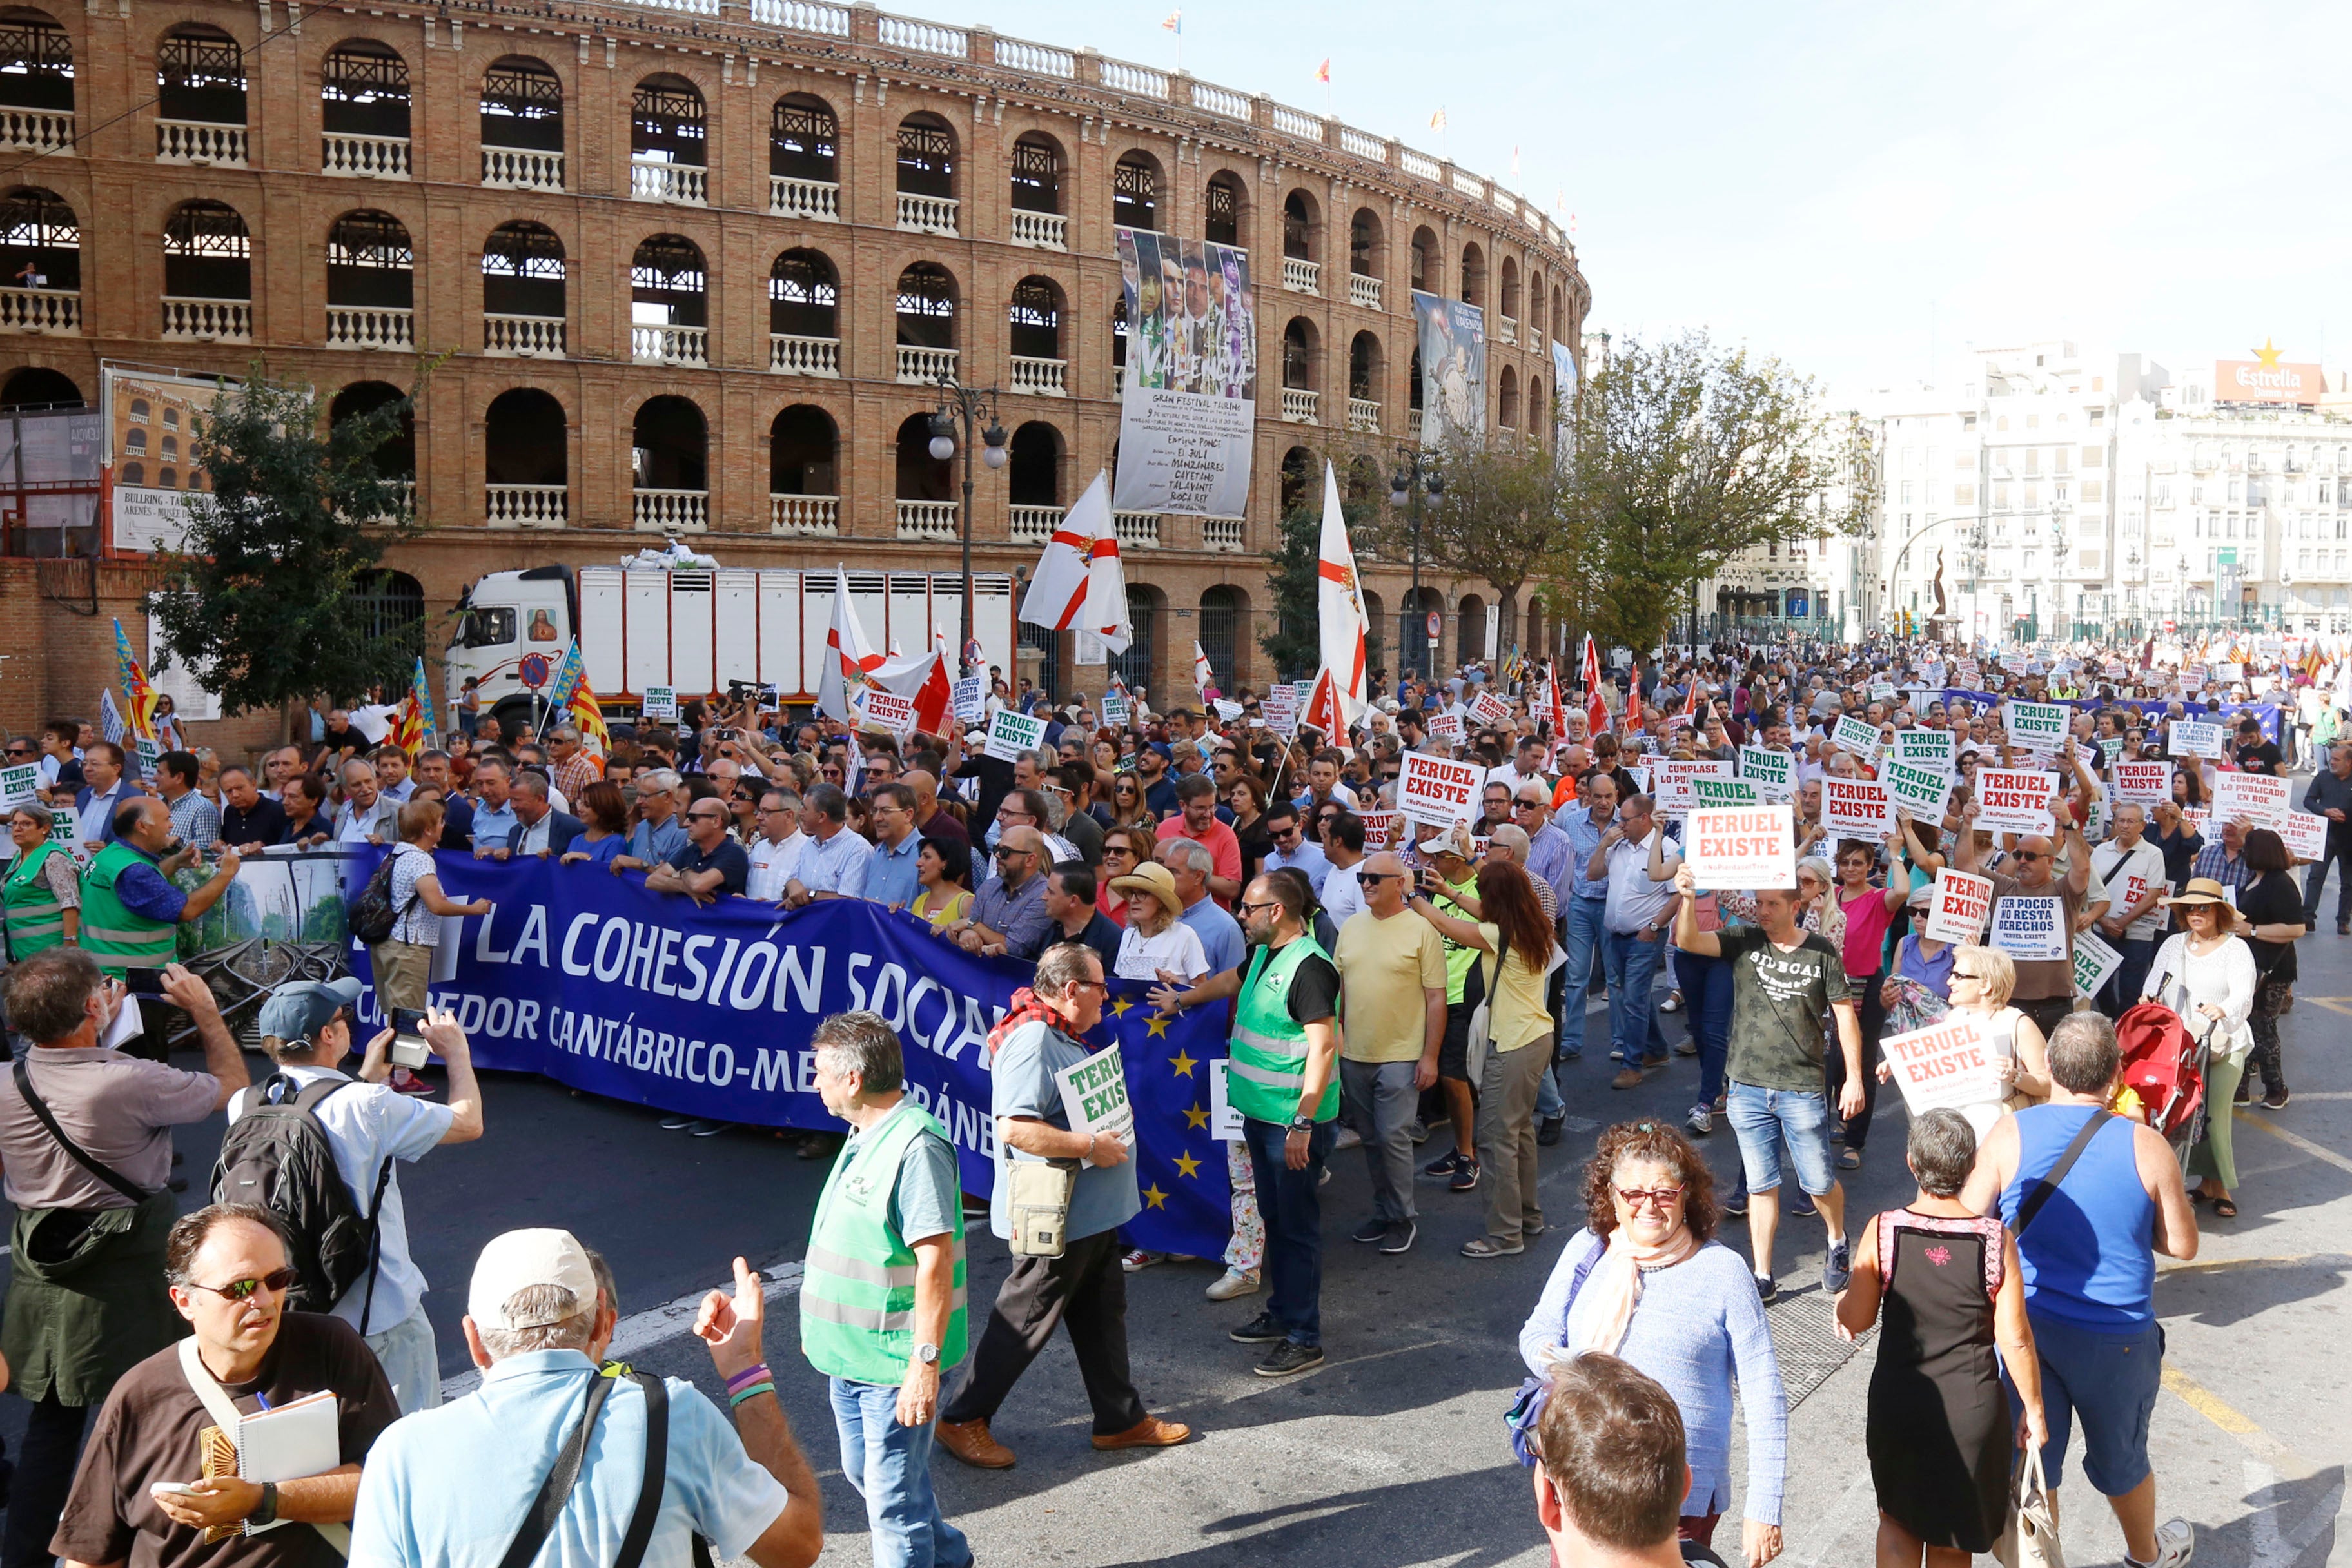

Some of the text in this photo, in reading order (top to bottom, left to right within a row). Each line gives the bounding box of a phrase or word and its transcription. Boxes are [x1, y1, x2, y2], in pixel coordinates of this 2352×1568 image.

[1140, 338, 1256, 385] VALENCIA
[2235, 366, 2301, 387] Estrella
[1153, 394, 1174, 404] GRAN
[1176, 397, 1210, 409] FESTIVAL
[1213, 401, 1241, 411] TAURINO
[1168, 435, 1222, 449] Enrique PONCE
[1171, 458, 1224, 472] MANZANARES
[1174, 469, 1215, 482] CAYETANO
[1168, 480, 1213, 492] TALAVANTE
[124, 492, 163, 505] BULLRING
[1170, 491, 1209, 504] ROCA REY
[647, 687, 672, 696] TERUEL
[961, 678, 980, 689] POCOS
[647, 696, 672, 705] EXISTE
[868, 692, 912, 710] TERUEL
[1482, 694, 1508, 716] TERUEL
[868, 703, 908, 721] EXISTE
[2013, 703, 2064, 720] TERUEL
[997, 711, 1039, 734] TERUEL
[1431, 716, 1458, 728] TERUEL
[1841, 718, 1876, 738] TERUEL
[2014, 717, 2061, 733] EXISTE
[994, 726, 1035, 747] EXISTE
[1838, 727, 1872, 746] EXISTE
[1901, 733, 1950, 745] TERUEL
[2176, 734, 2215, 743] DERECHOS
[1743, 749, 1788, 769] TERUEL
[1903, 746, 1948, 758] EXISTE
[2, 765, 37, 783] TERUEL
[1408, 757, 1475, 787] TERUEL
[1661, 775, 1672, 783] LO
[1743, 765, 1786, 784] EXISTE
[1888, 761, 1946, 790] TERUEL
[2116, 765, 2165, 776] TERUEL
[5, 779, 36, 794] EXISTE
[1692, 779, 1757, 799] TERUEL
[1983, 772, 2051, 792] TERUEL
[2119, 777, 2164, 790] EXISTE
[2230, 774, 2279, 787] CÚMPLASE
[1406, 776, 1470, 805] EXISTE
[1676, 786, 1689, 795] EN
[1828, 782, 1888, 802] TERUEL
[2235, 785, 2286, 798] PUBLICADO
[1983, 790, 2047, 810] EXISTE
[2251, 796, 2270, 805] BOE
[1829, 800, 1886, 819] EXISTE
[1697, 813, 1782, 834] TERUEL
[2287, 821, 2322, 832] BLICADO
[2289, 814, 2315, 823] PLASE
[2291, 830, 2307, 838] BOE
[1699, 837, 1780, 857] EXISTE
[2001, 898, 2054, 909] SER POCOS
[2001, 909, 2052, 920] NO RESTA
[1999, 921, 2054, 932] DERECHOS
[2073, 949, 2102, 979] EXIS
[476, 903, 1006, 1072] LA COHESIÓN SOCIA
[1892, 1024, 1981, 1061] TERUEL
[1068, 1047, 1123, 1096] TERU
[1906, 1048, 1986, 1083] EXISTE
[1081, 1077, 1126, 1123] EXIS
